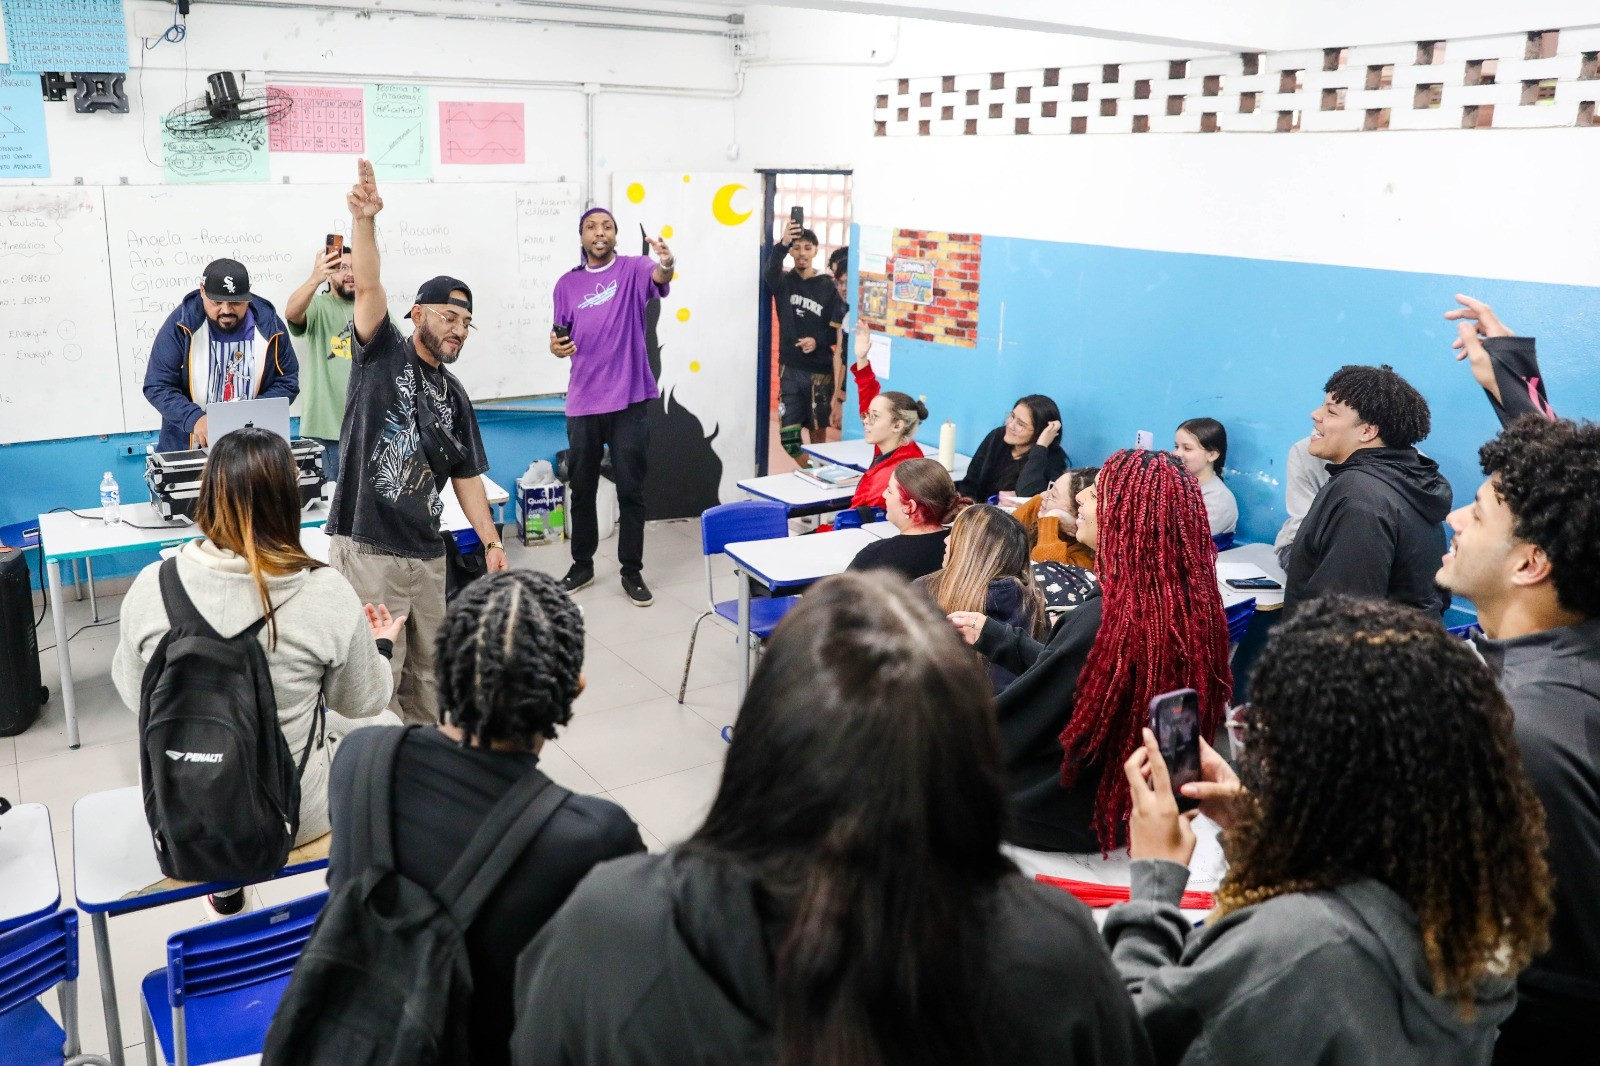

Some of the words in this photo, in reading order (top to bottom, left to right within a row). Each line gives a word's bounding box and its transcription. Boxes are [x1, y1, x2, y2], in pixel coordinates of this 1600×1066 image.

[126, 229, 182, 255] Angela
[129, 250, 165, 269] Ana
[232, 248, 293, 264] Rascunho
